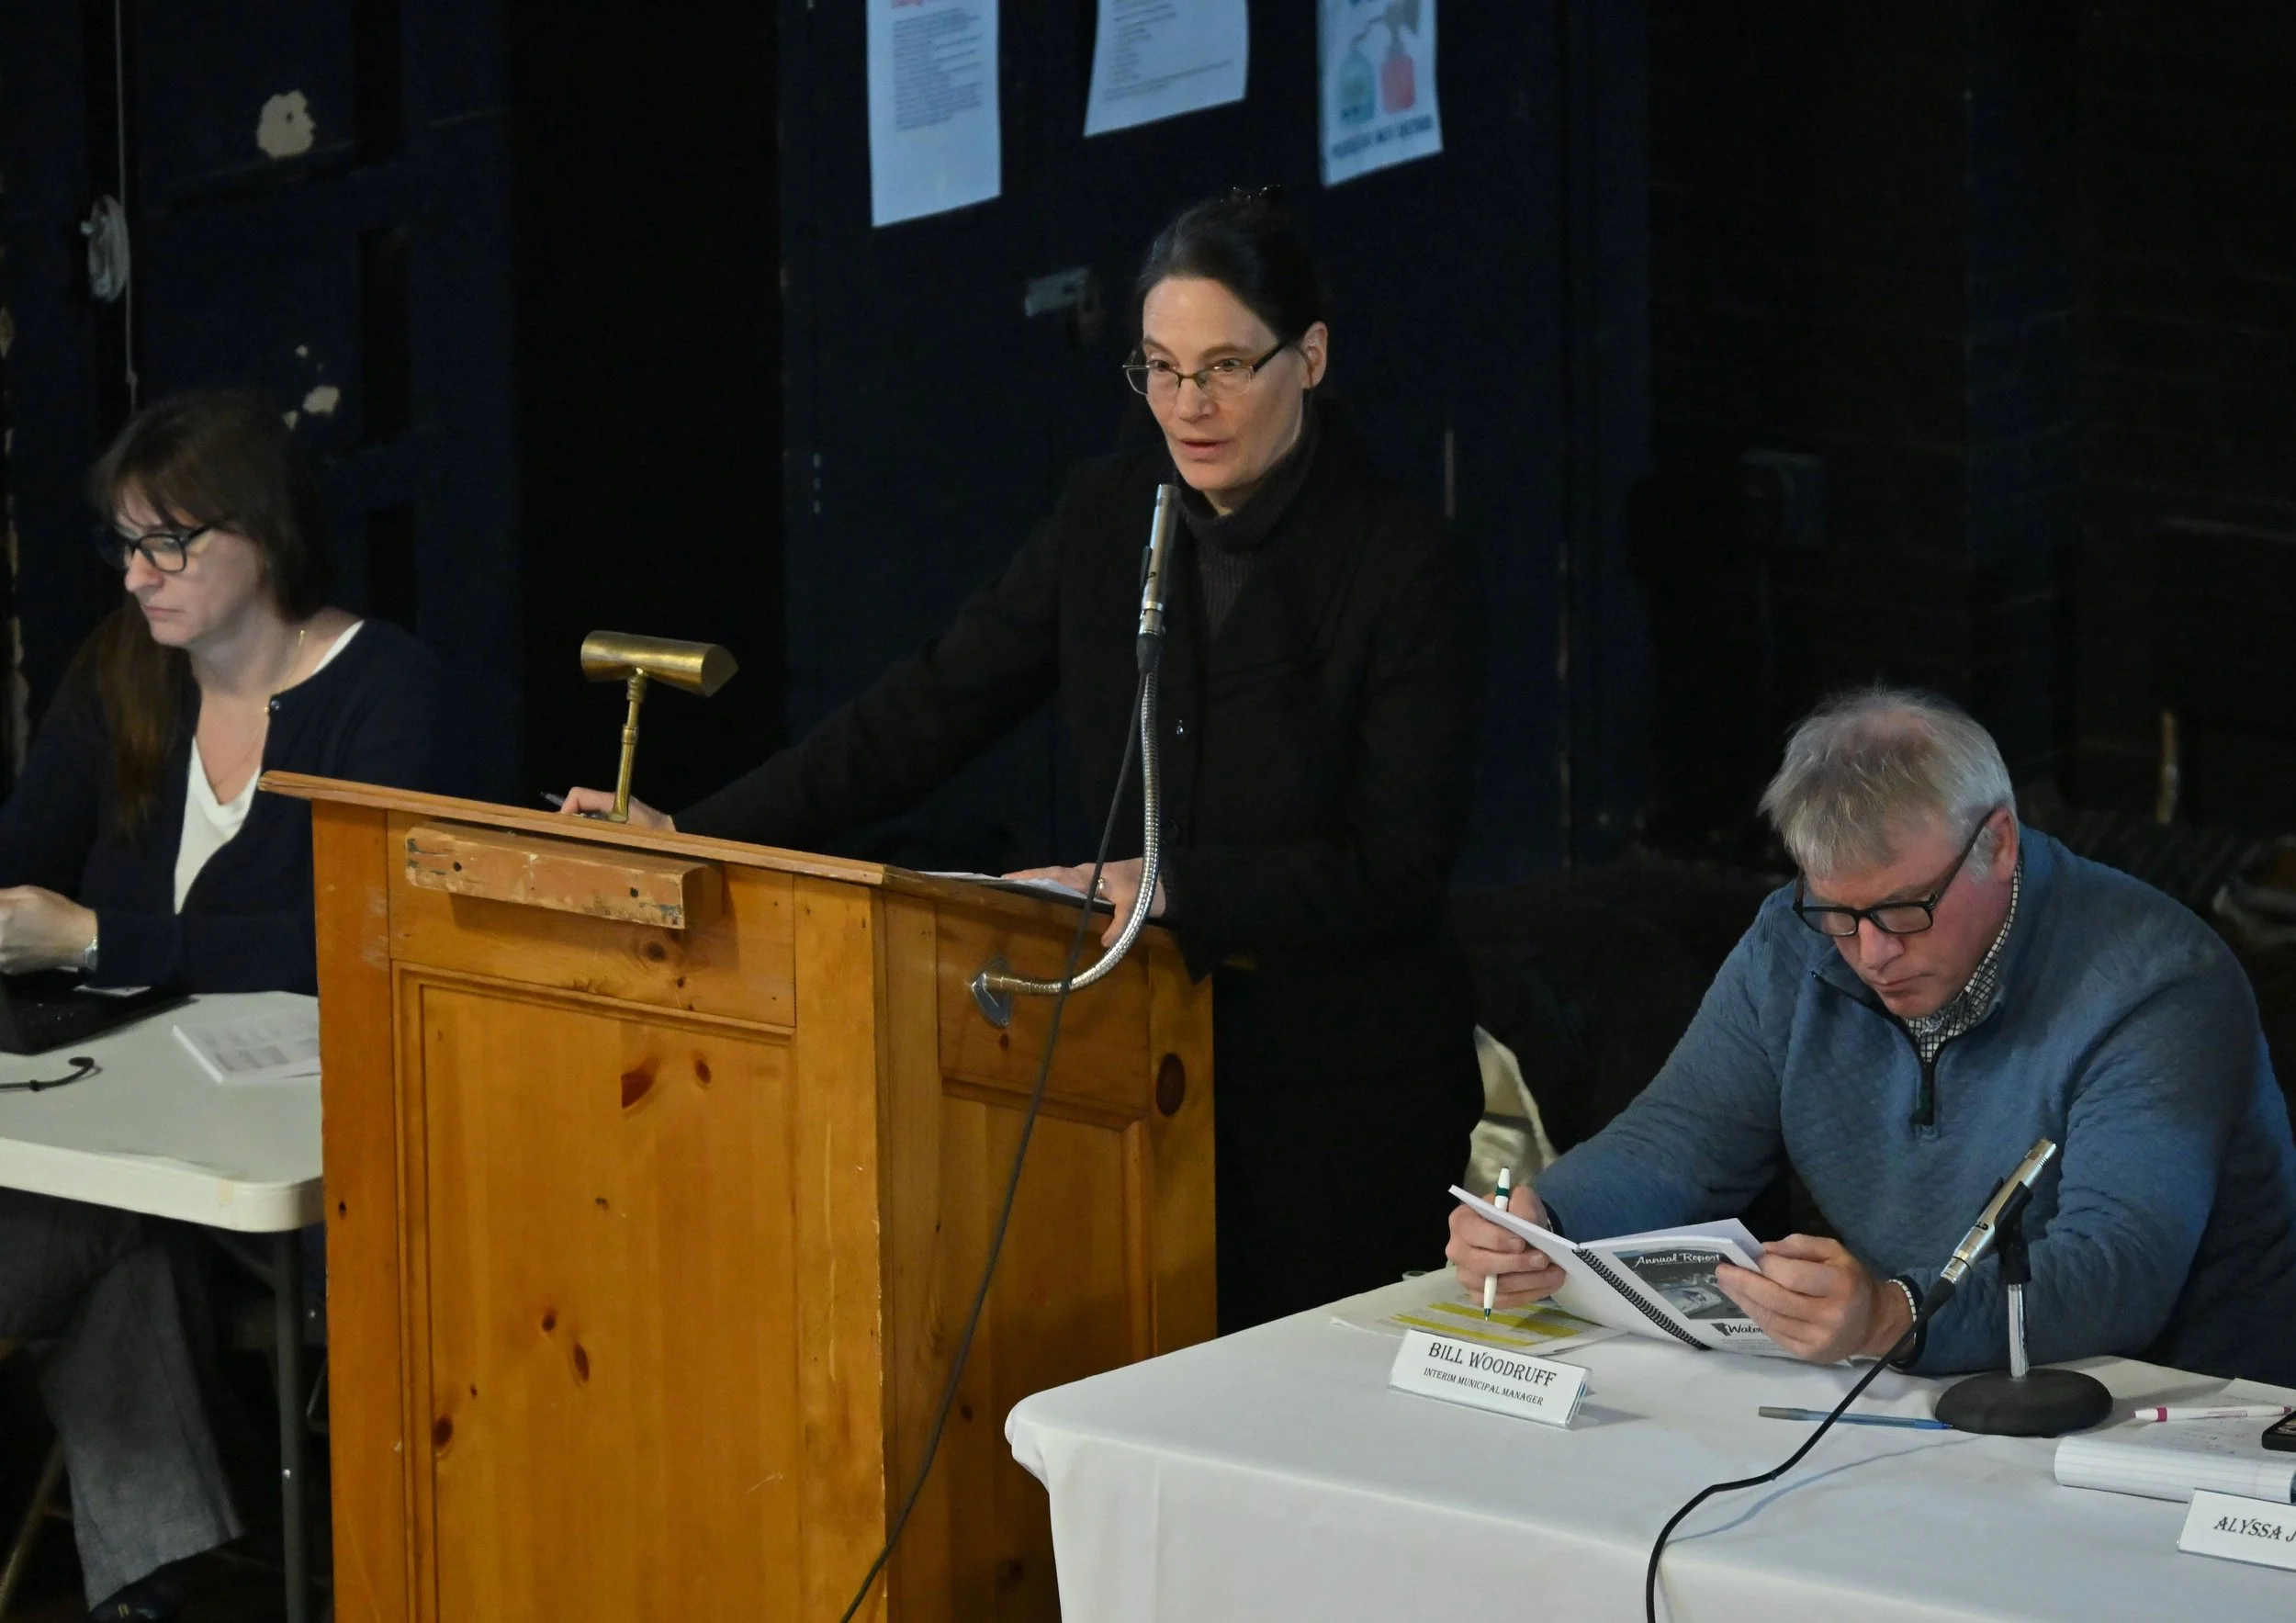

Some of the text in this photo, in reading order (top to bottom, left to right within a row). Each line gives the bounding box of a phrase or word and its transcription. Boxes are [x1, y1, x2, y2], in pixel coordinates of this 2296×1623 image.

[1635, 1252, 1721, 1268] Annual Report
[1428, 1342, 1558, 1387] BILL WOODRUFF
[1424, 1367, 1544, 1406] INTERIM MUNICIPAL MANAGER
[2212, 1516, 2283, 1540] ALYSSA
